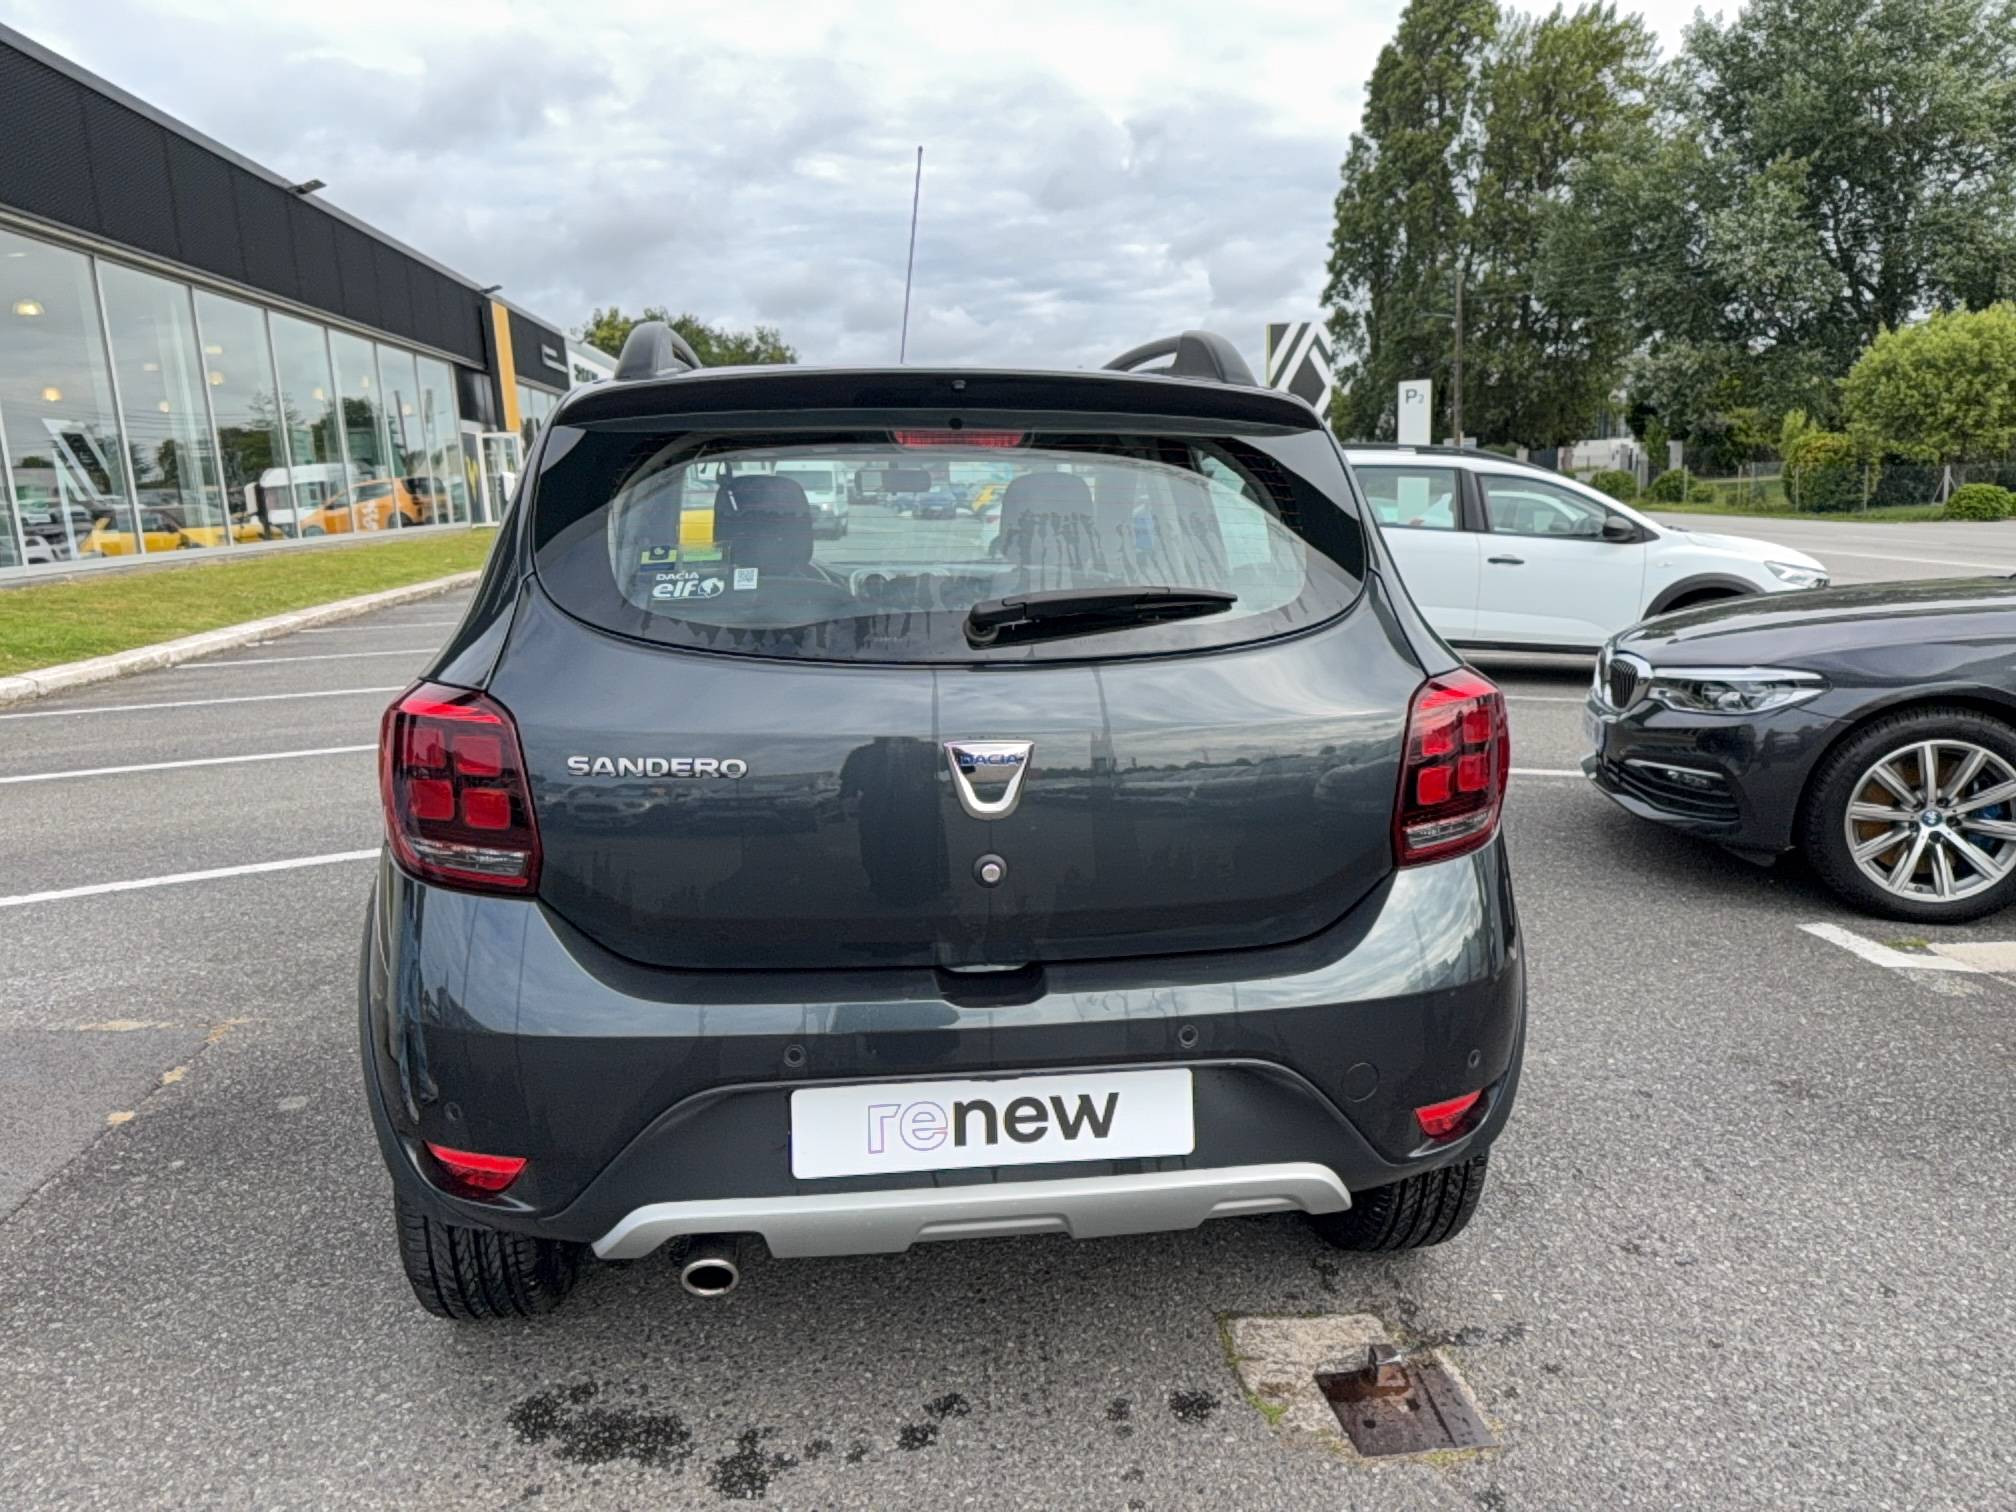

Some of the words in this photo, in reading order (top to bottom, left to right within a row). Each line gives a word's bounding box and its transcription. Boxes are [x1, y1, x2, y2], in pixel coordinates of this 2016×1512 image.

[656, 571, 699, 580] DACIA
[652, 580, 699, 597] elf
[567, 756, 748, 778] SANDERO
[960, 753, 1019, 765] DACIA
[867, 1092, 1120, 1154] renew
